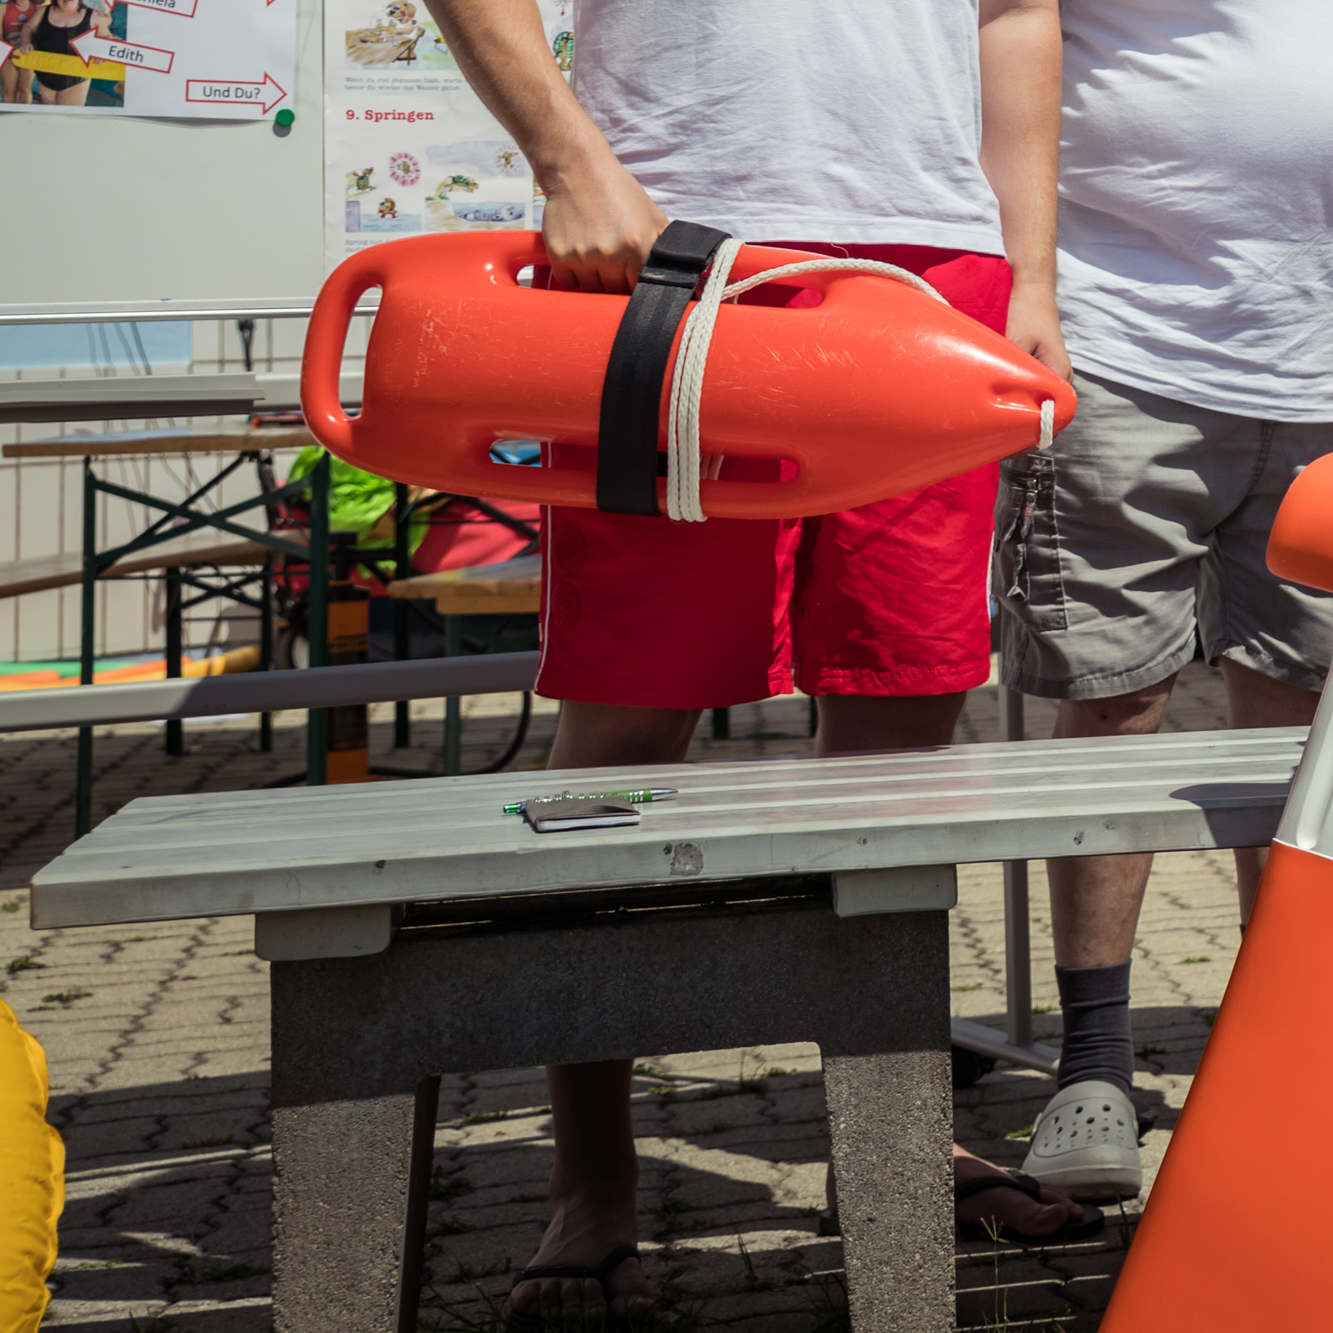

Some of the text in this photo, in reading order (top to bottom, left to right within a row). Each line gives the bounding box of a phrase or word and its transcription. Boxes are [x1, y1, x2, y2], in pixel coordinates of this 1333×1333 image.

[108, 45, 144, 63] Edith
[203, 87, 261, 99] Und Du?
[346, 109, 434, 122] 9. Springen
